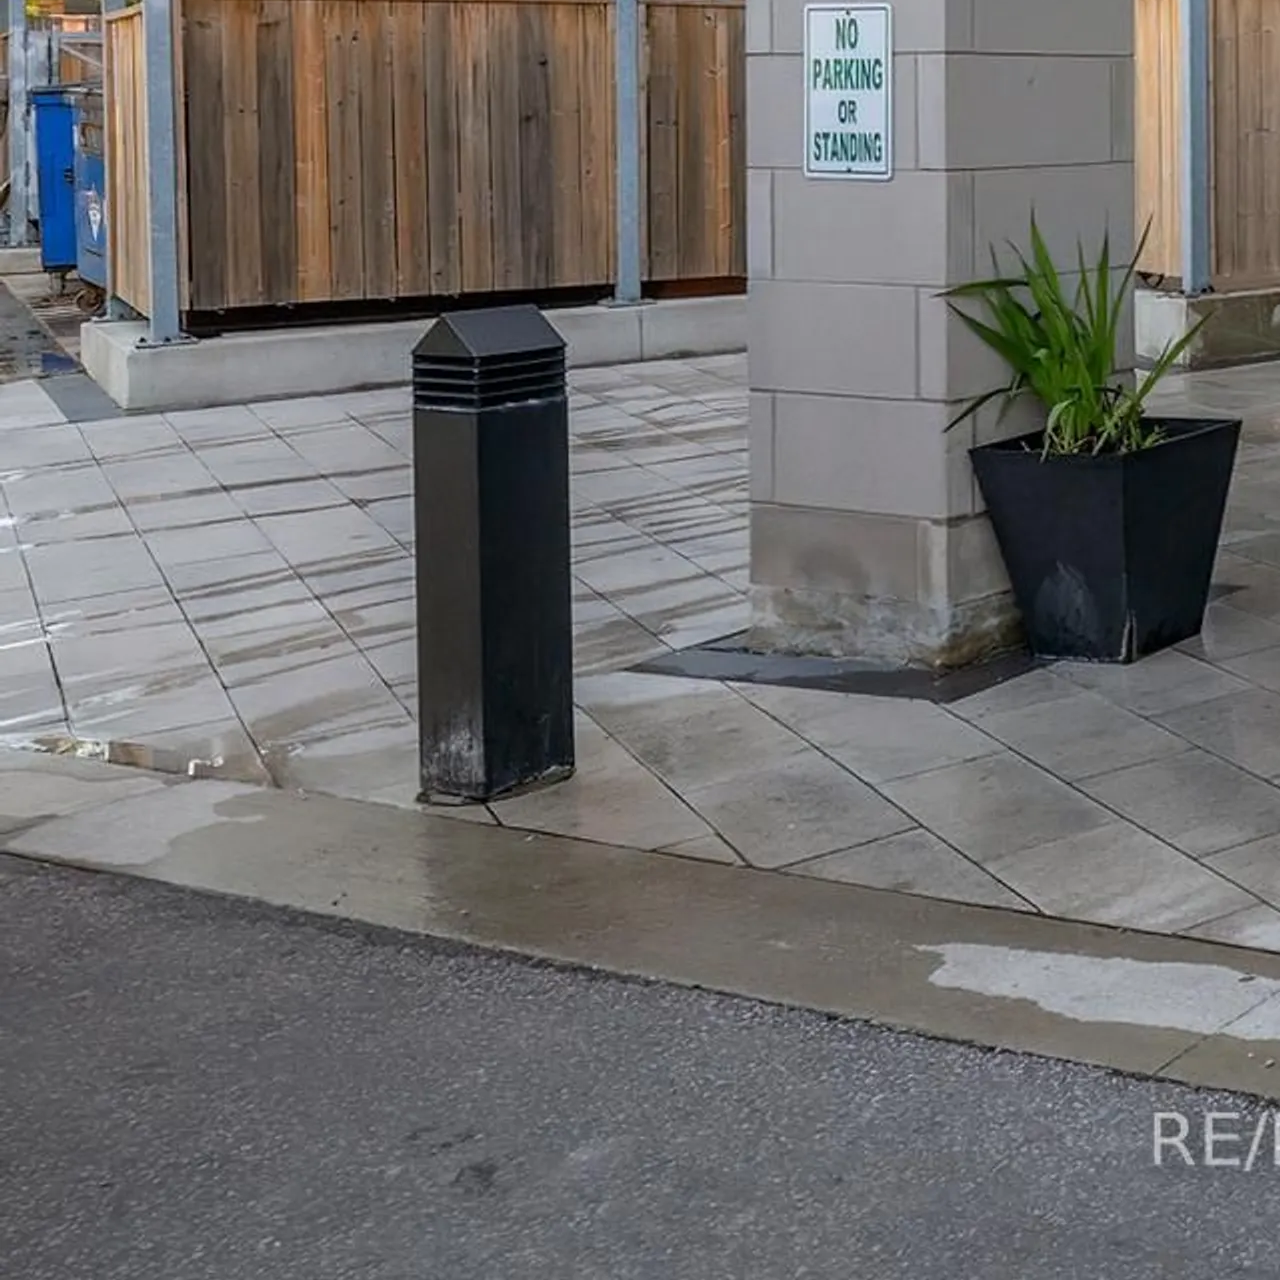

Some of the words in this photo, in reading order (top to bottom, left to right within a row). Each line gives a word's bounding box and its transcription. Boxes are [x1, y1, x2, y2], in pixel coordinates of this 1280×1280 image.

[835, 17, 859, 50] NO
[812, 57, 884, 91] PARKING
[837, 99, 858, 125] OR
[813, 131, 883, 164] STANDING
